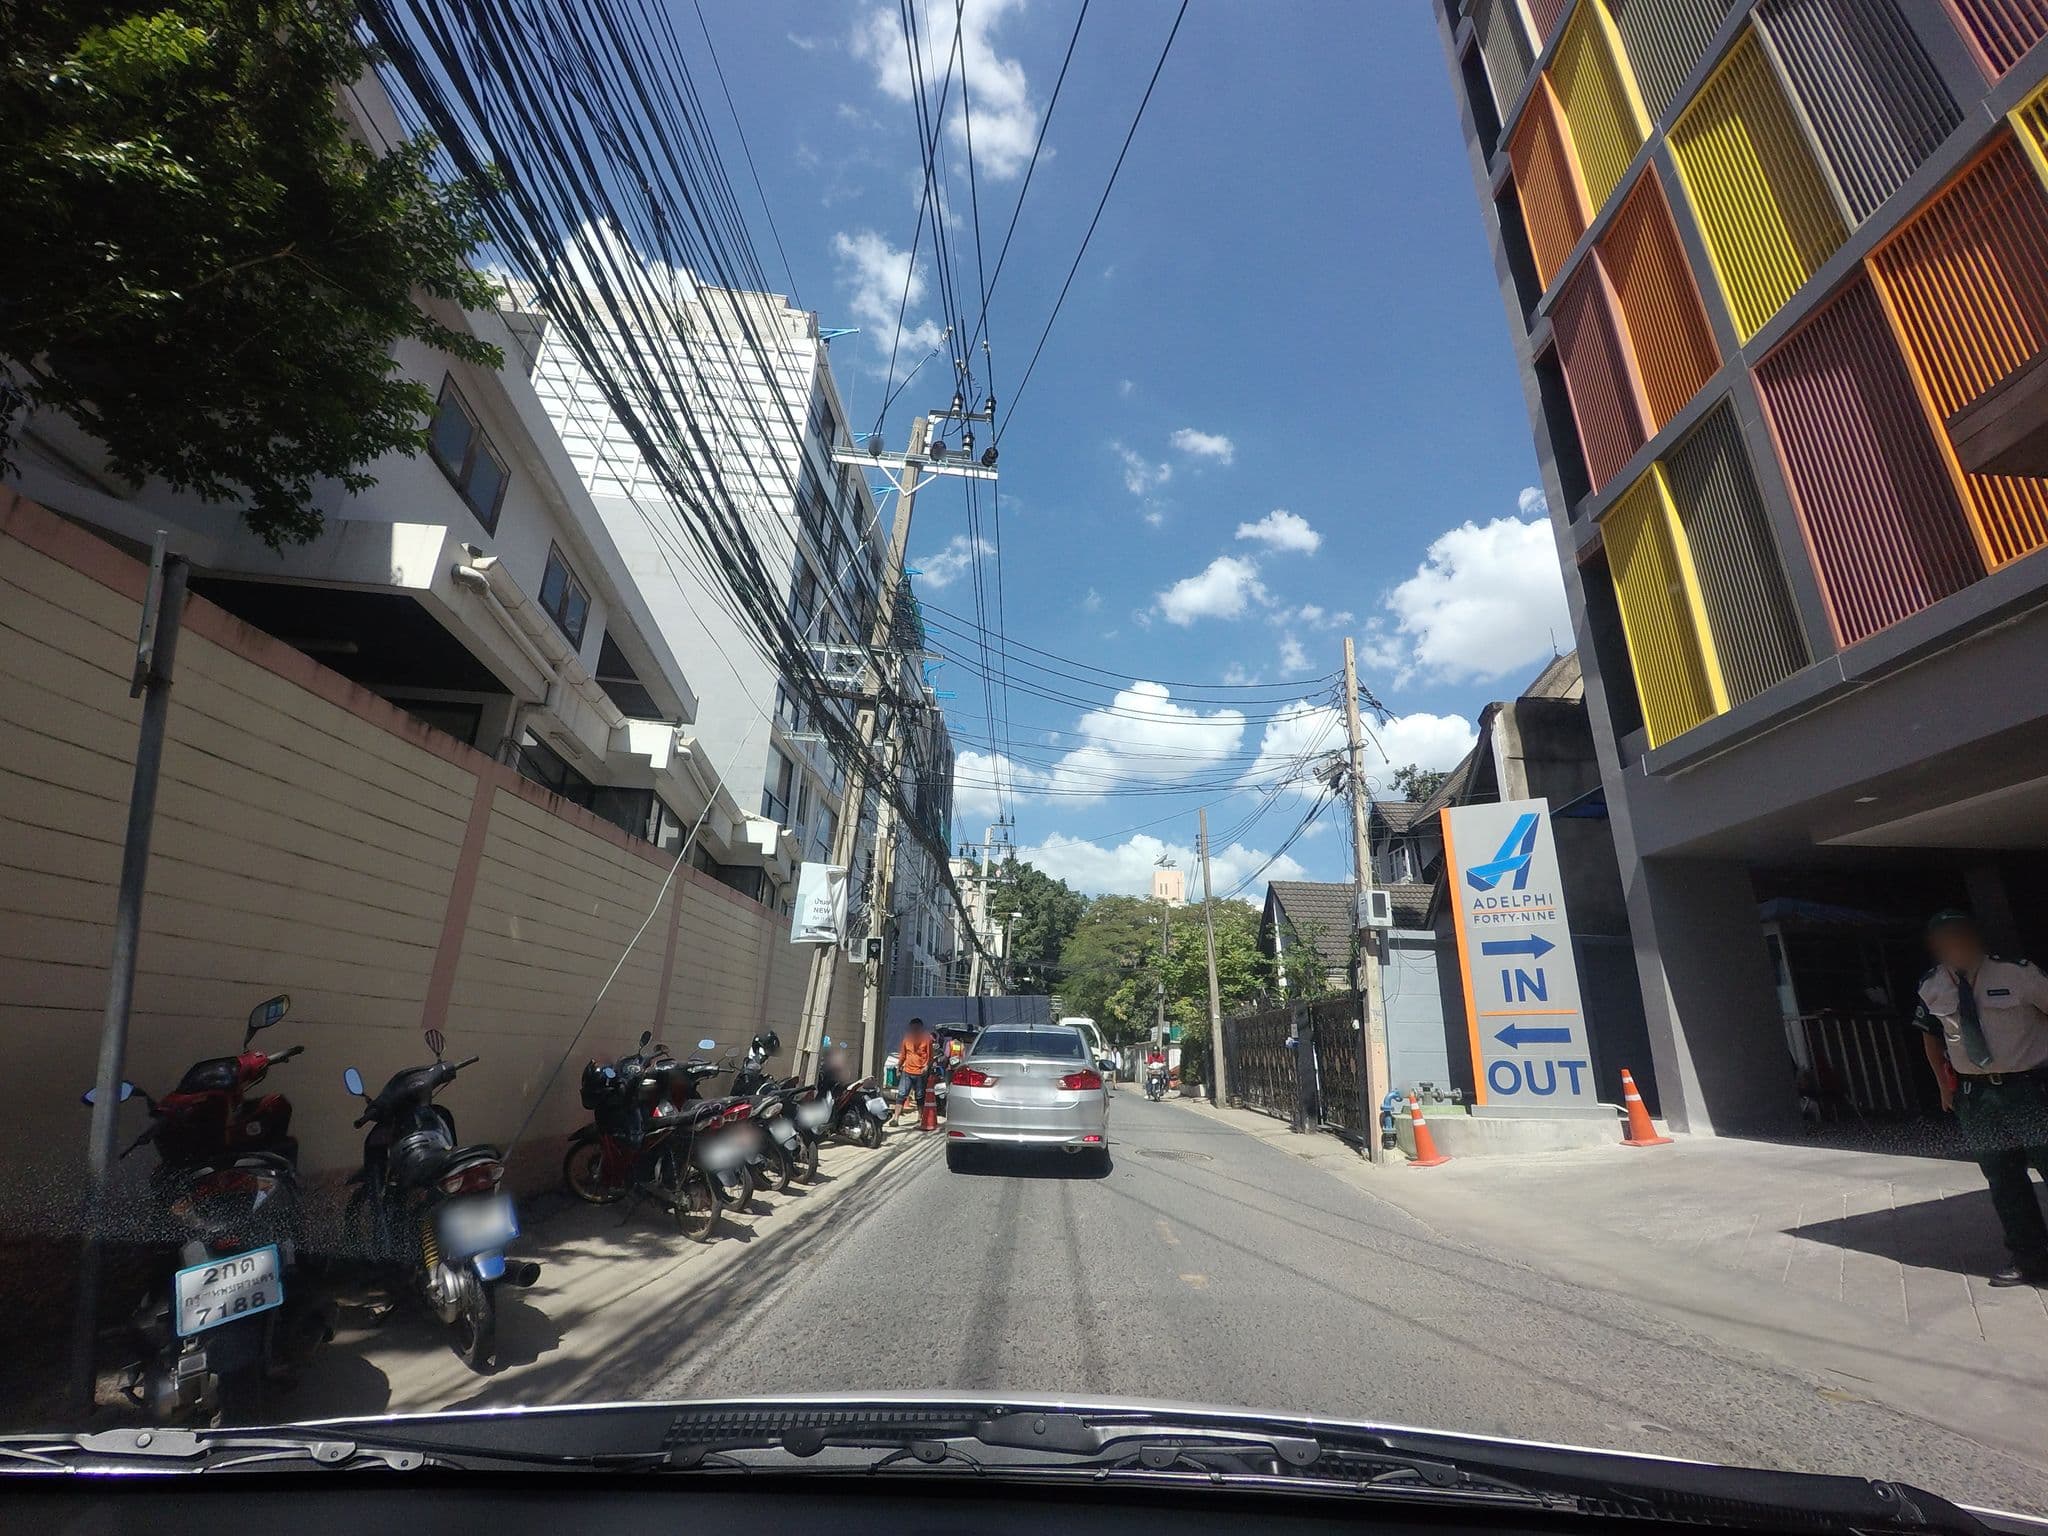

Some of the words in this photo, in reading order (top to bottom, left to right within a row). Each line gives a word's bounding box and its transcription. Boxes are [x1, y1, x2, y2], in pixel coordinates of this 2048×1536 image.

[1473, 893, 1553, 910] ADELPHI
[1473, 910, 1556, 924] FORTY-NINE
[1501, 967, 1549, 1003] IN
[1487, 1060, 1588, 1096] OUT
[203, 1257, 255, 1286] 2กด
[195, 1291, 266, 1326] 7188
